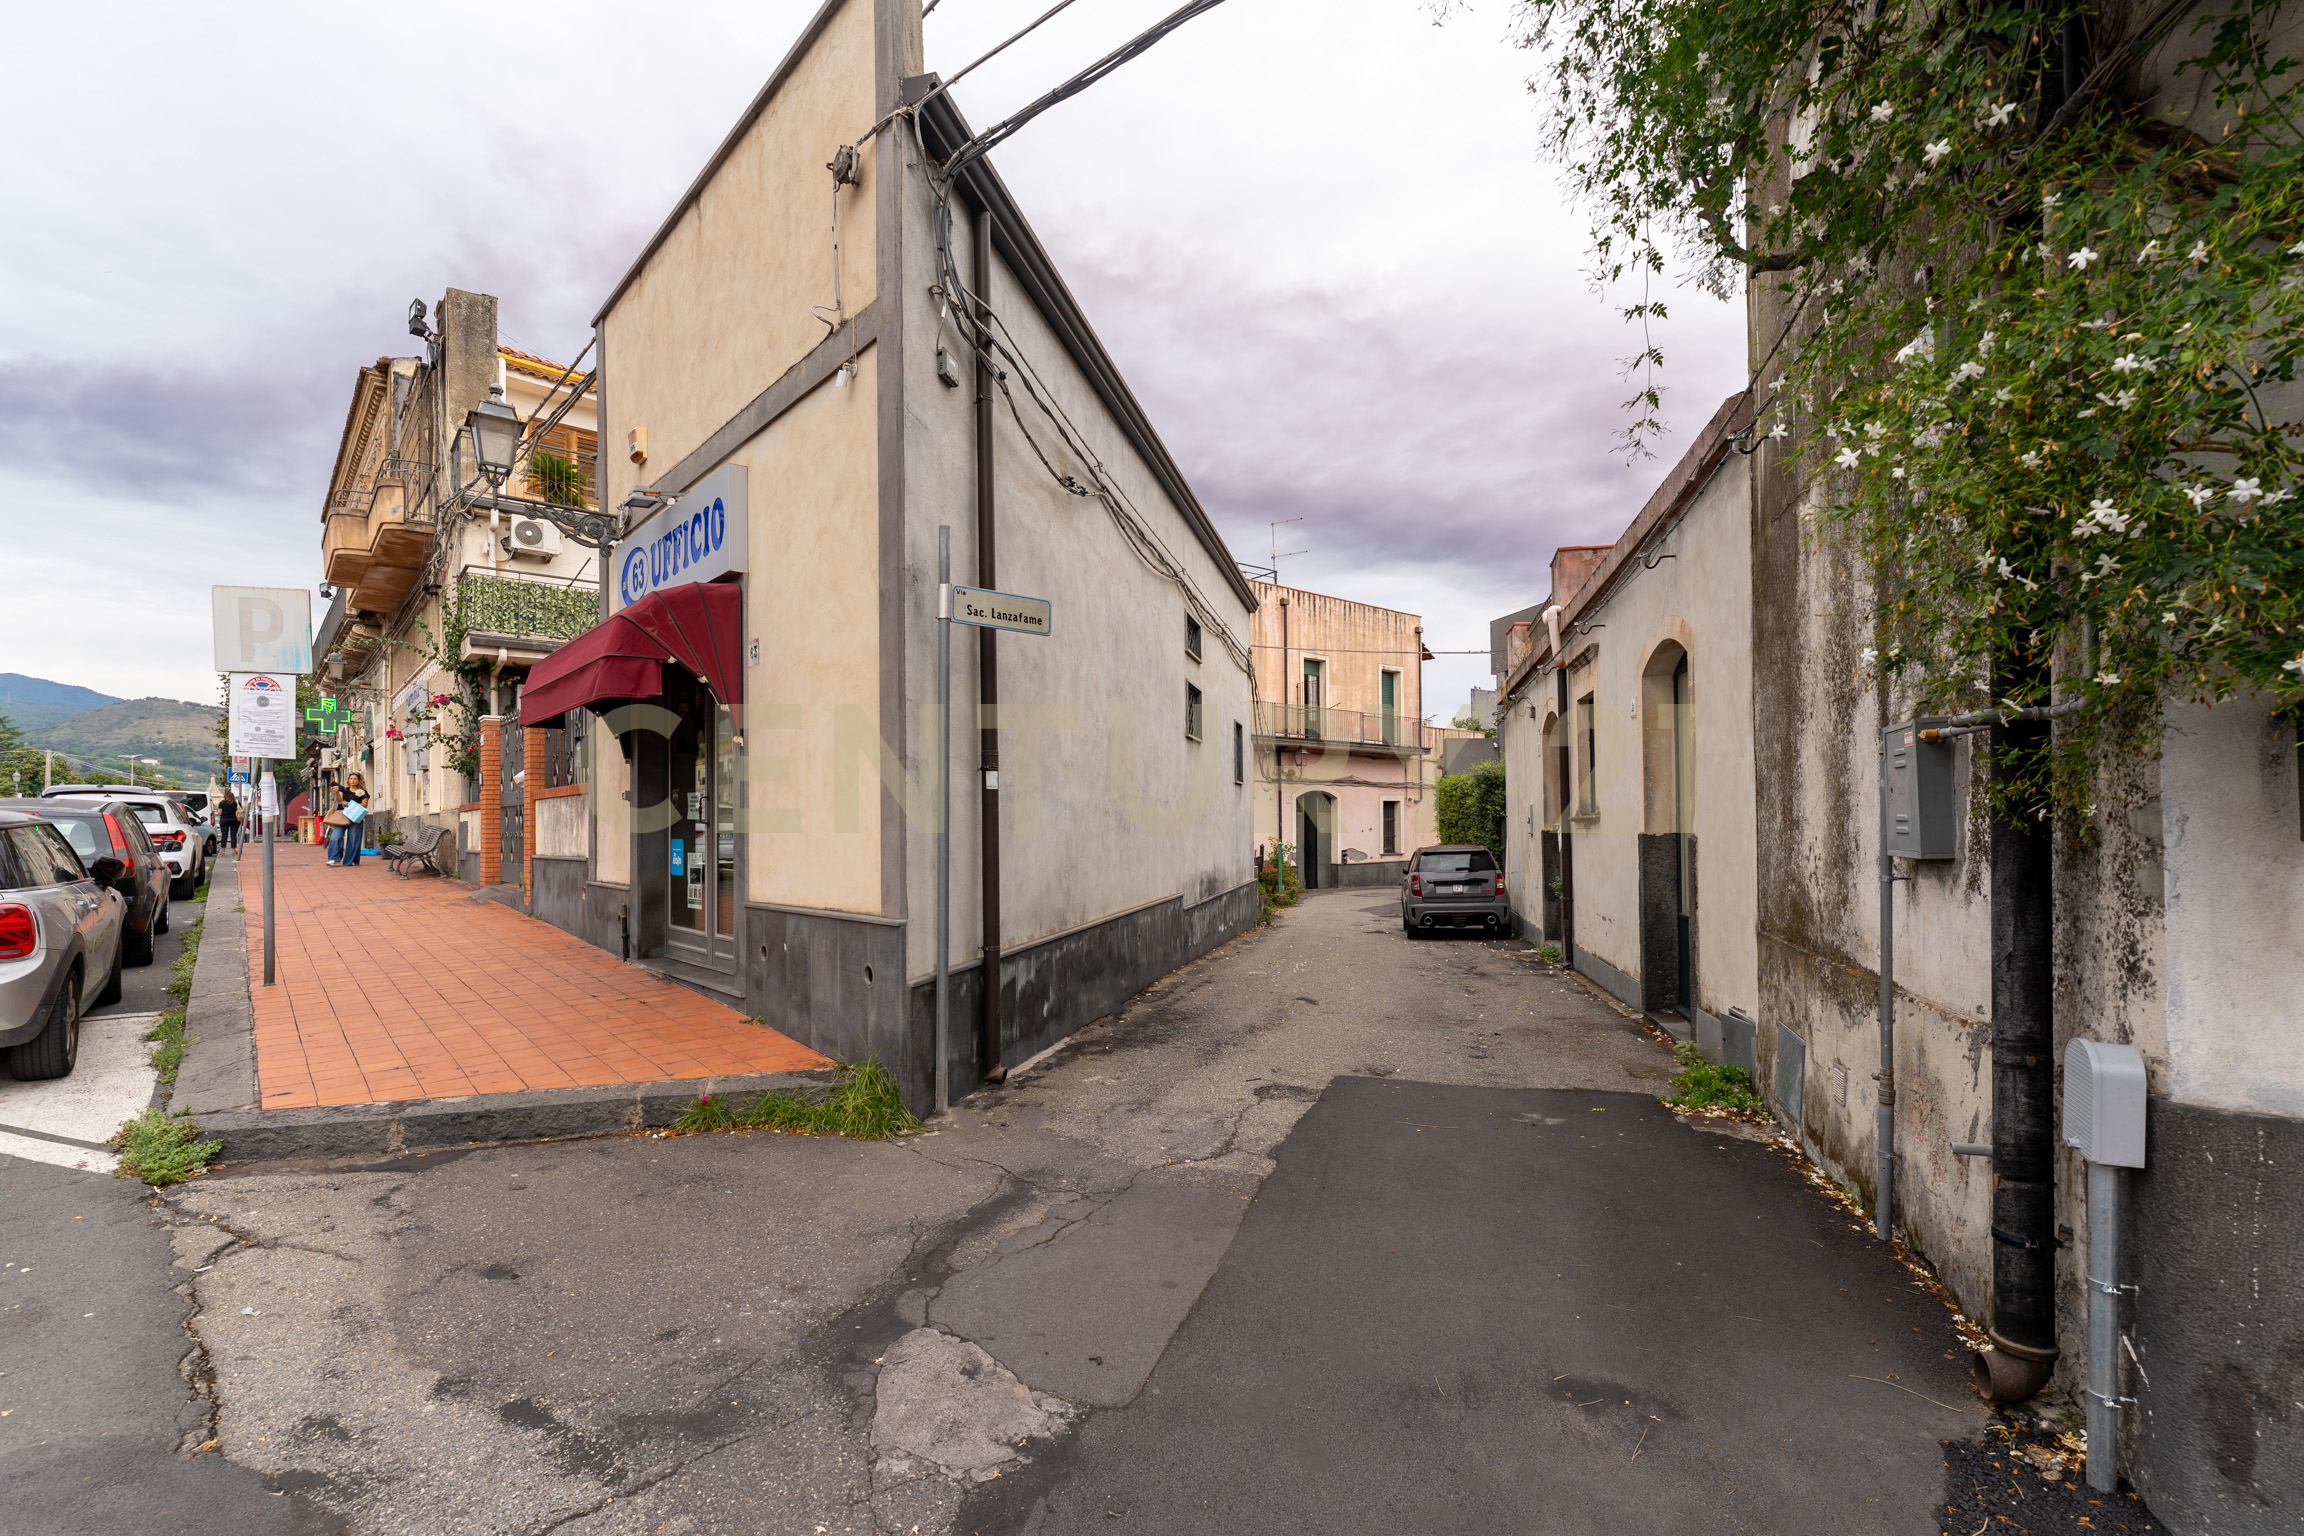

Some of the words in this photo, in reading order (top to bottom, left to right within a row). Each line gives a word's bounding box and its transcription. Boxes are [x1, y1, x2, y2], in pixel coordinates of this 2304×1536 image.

[632, 558, 645, 593] 63
[651, 497, 725, 588] UFFICIO
[956, 588, 966, 596] Via
[238, 597, 283, 662] P
[966, 604, 988, 618] Sac.
[991, 608, 1043, 626] Lanzafame
